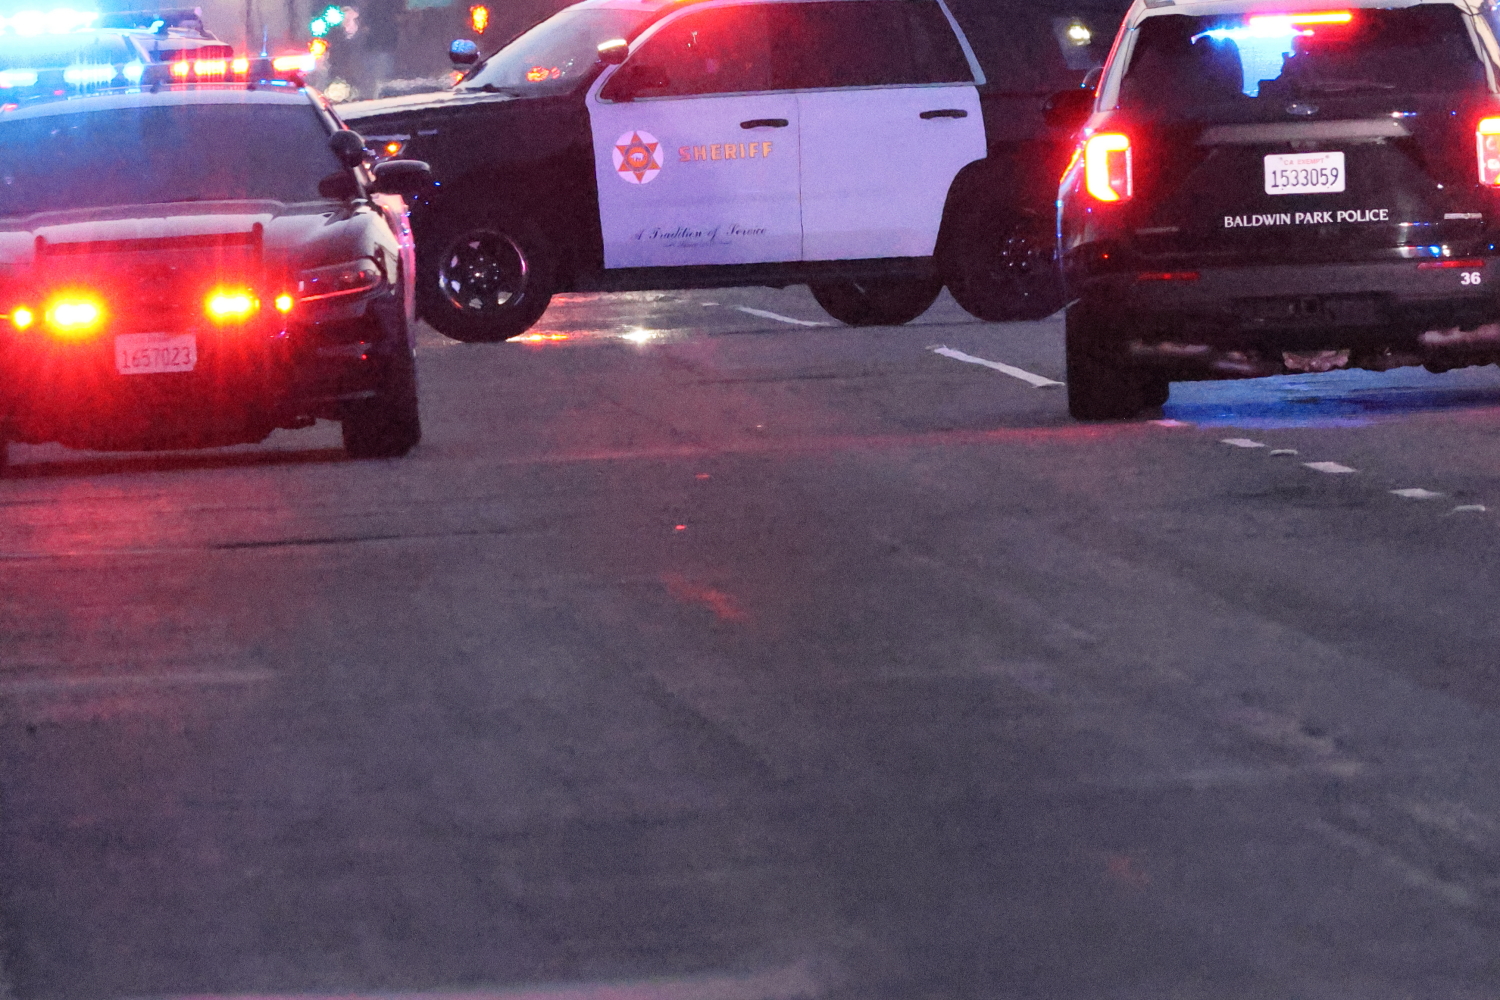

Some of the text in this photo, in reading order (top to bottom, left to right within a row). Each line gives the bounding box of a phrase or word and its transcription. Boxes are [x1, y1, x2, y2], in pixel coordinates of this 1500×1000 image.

[677, 141, 774, 163] SHERIFF
[1297, 157, 1325, 165] EXEMPT
[1271, 167, 1339, 188] 1533059
[1224, 208, 1389, 228] BALDWIN PARK POLICE
[649, 227, 702, 239] Tradition
[706, 225, 721, 242] of
[1460, 271, 1482, 285] 36
[122, 346, 191, 369] 1657023
